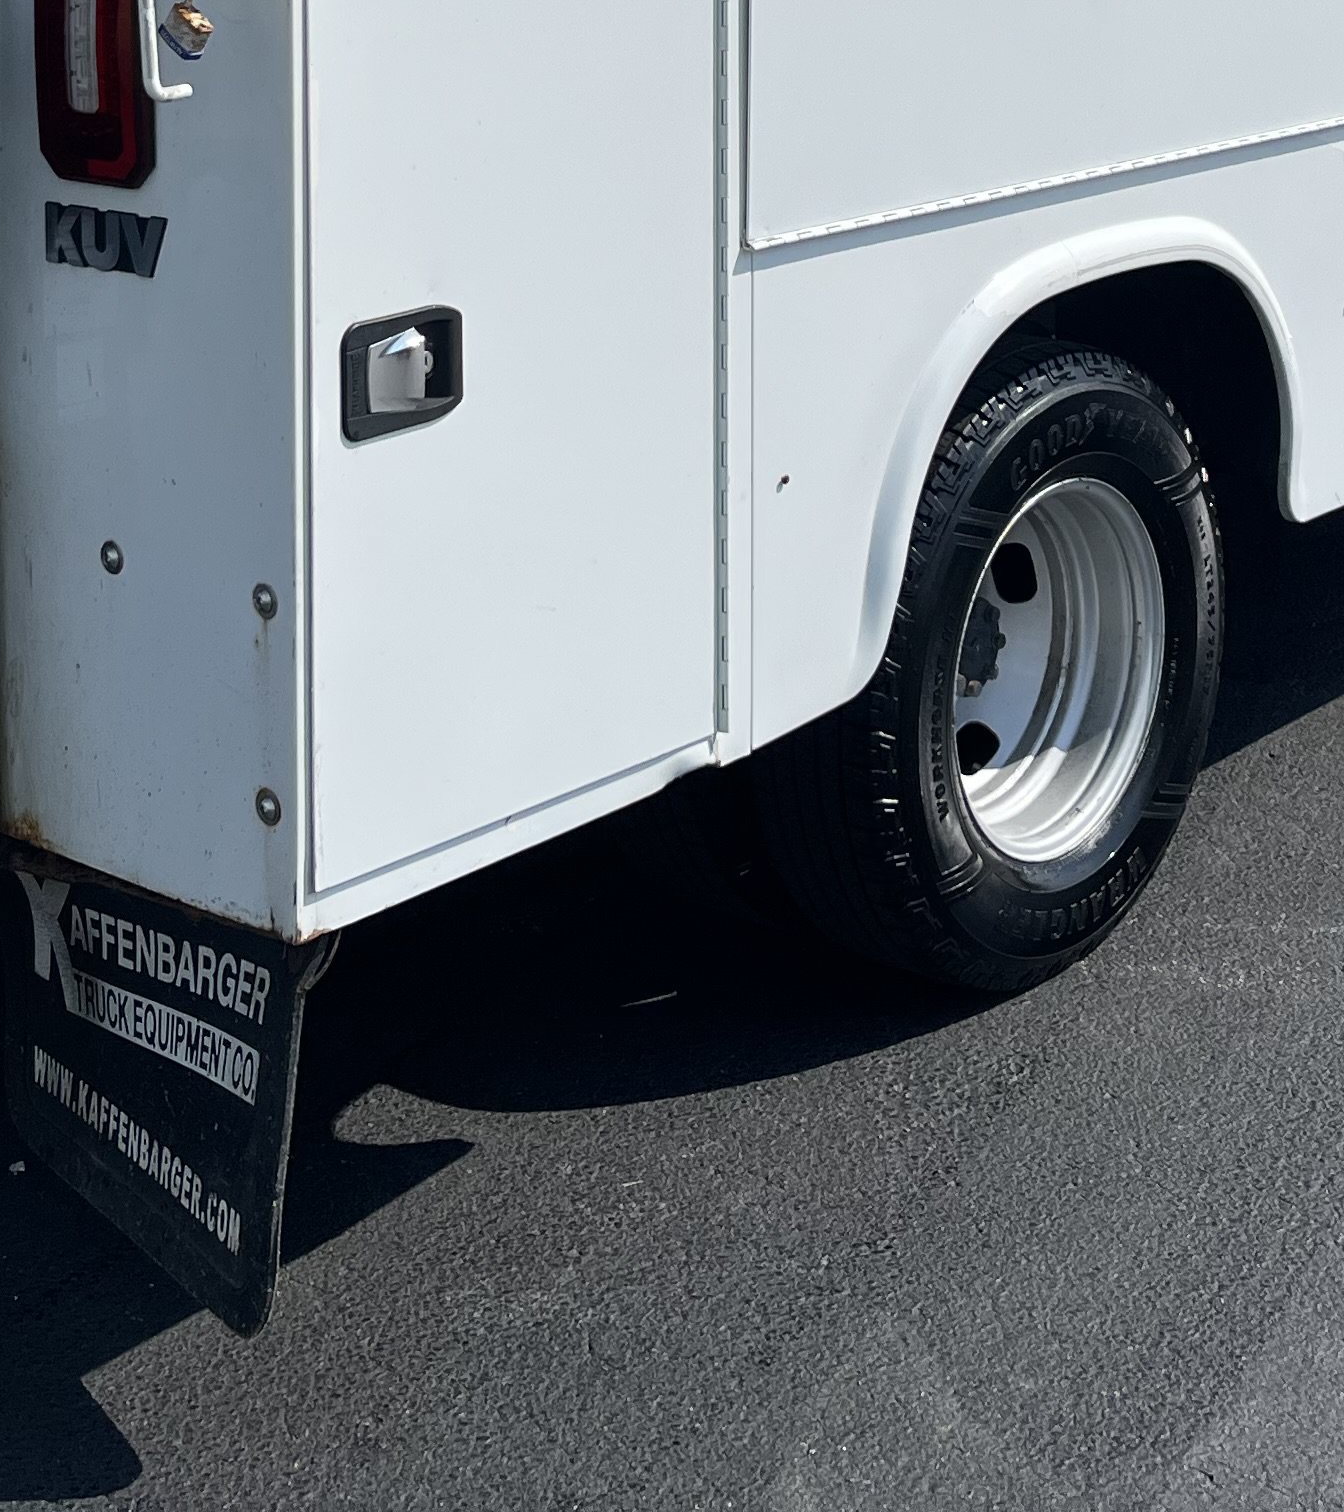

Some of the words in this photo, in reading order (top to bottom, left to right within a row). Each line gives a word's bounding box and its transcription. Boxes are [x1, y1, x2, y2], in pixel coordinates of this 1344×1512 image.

[44, 200, 169, 278] KUV
[14, 870, 271, 1026] KAFFENBARGER
[72, 968, 131, 1036] TRUCK
[132, 997, 233, 1083] EQUIPMENT
[230, 1044, 255, 1101] CO.
[33, 1044, 242, 1257] WWW.KAFFENBARGER.COM
